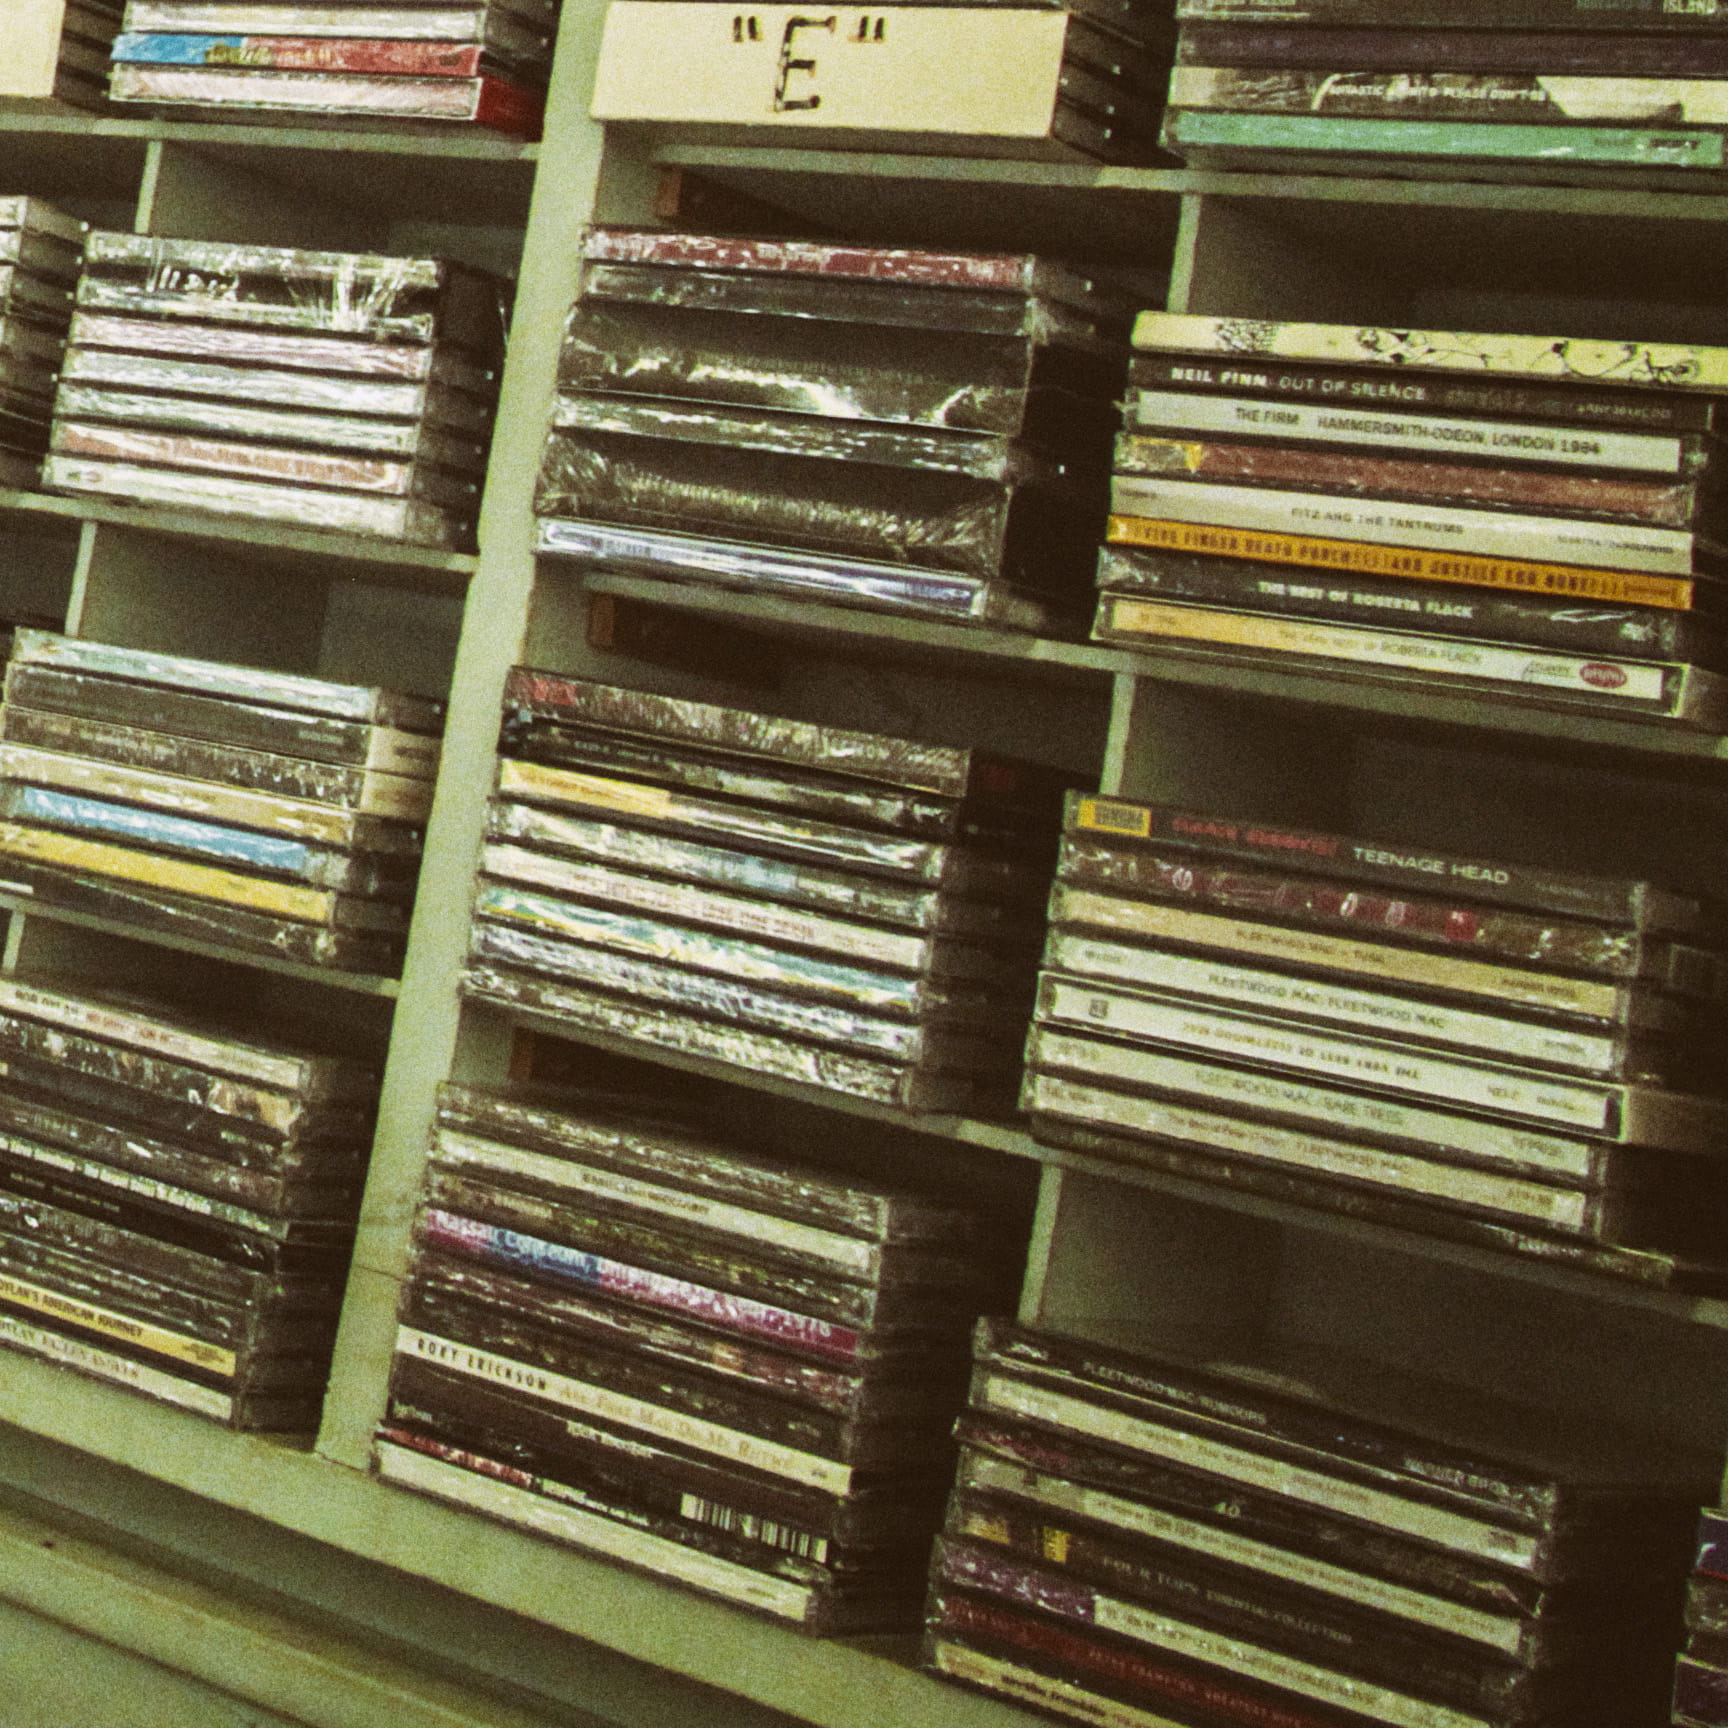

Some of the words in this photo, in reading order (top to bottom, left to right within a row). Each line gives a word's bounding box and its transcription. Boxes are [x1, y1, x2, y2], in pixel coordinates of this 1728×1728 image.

[1170, 367, 1212, 384] NEIL
[1219, 370, 1267, 388] FINN
[1278, 375, 1312, 392] OUT
[1321, 378, 1345, 394] OF
[1350, 381, 1426, 400] SILENCE
[1234, 407, 1260, 422] THE
[1263, 409, 1299, 426] FIRM
[1492, 431, 1554, 450] LONDON
[1256, 580, 1285, 597] THE
[1327, 589, 1348, 604] OF
[1351, 591, 1419, 612] ROBERTA
[1423, 600, 1472, 618] FLACK
[1352, 846, 1446, 875] TEENAGE
[1451, 862, 1510, 885] HEAD
